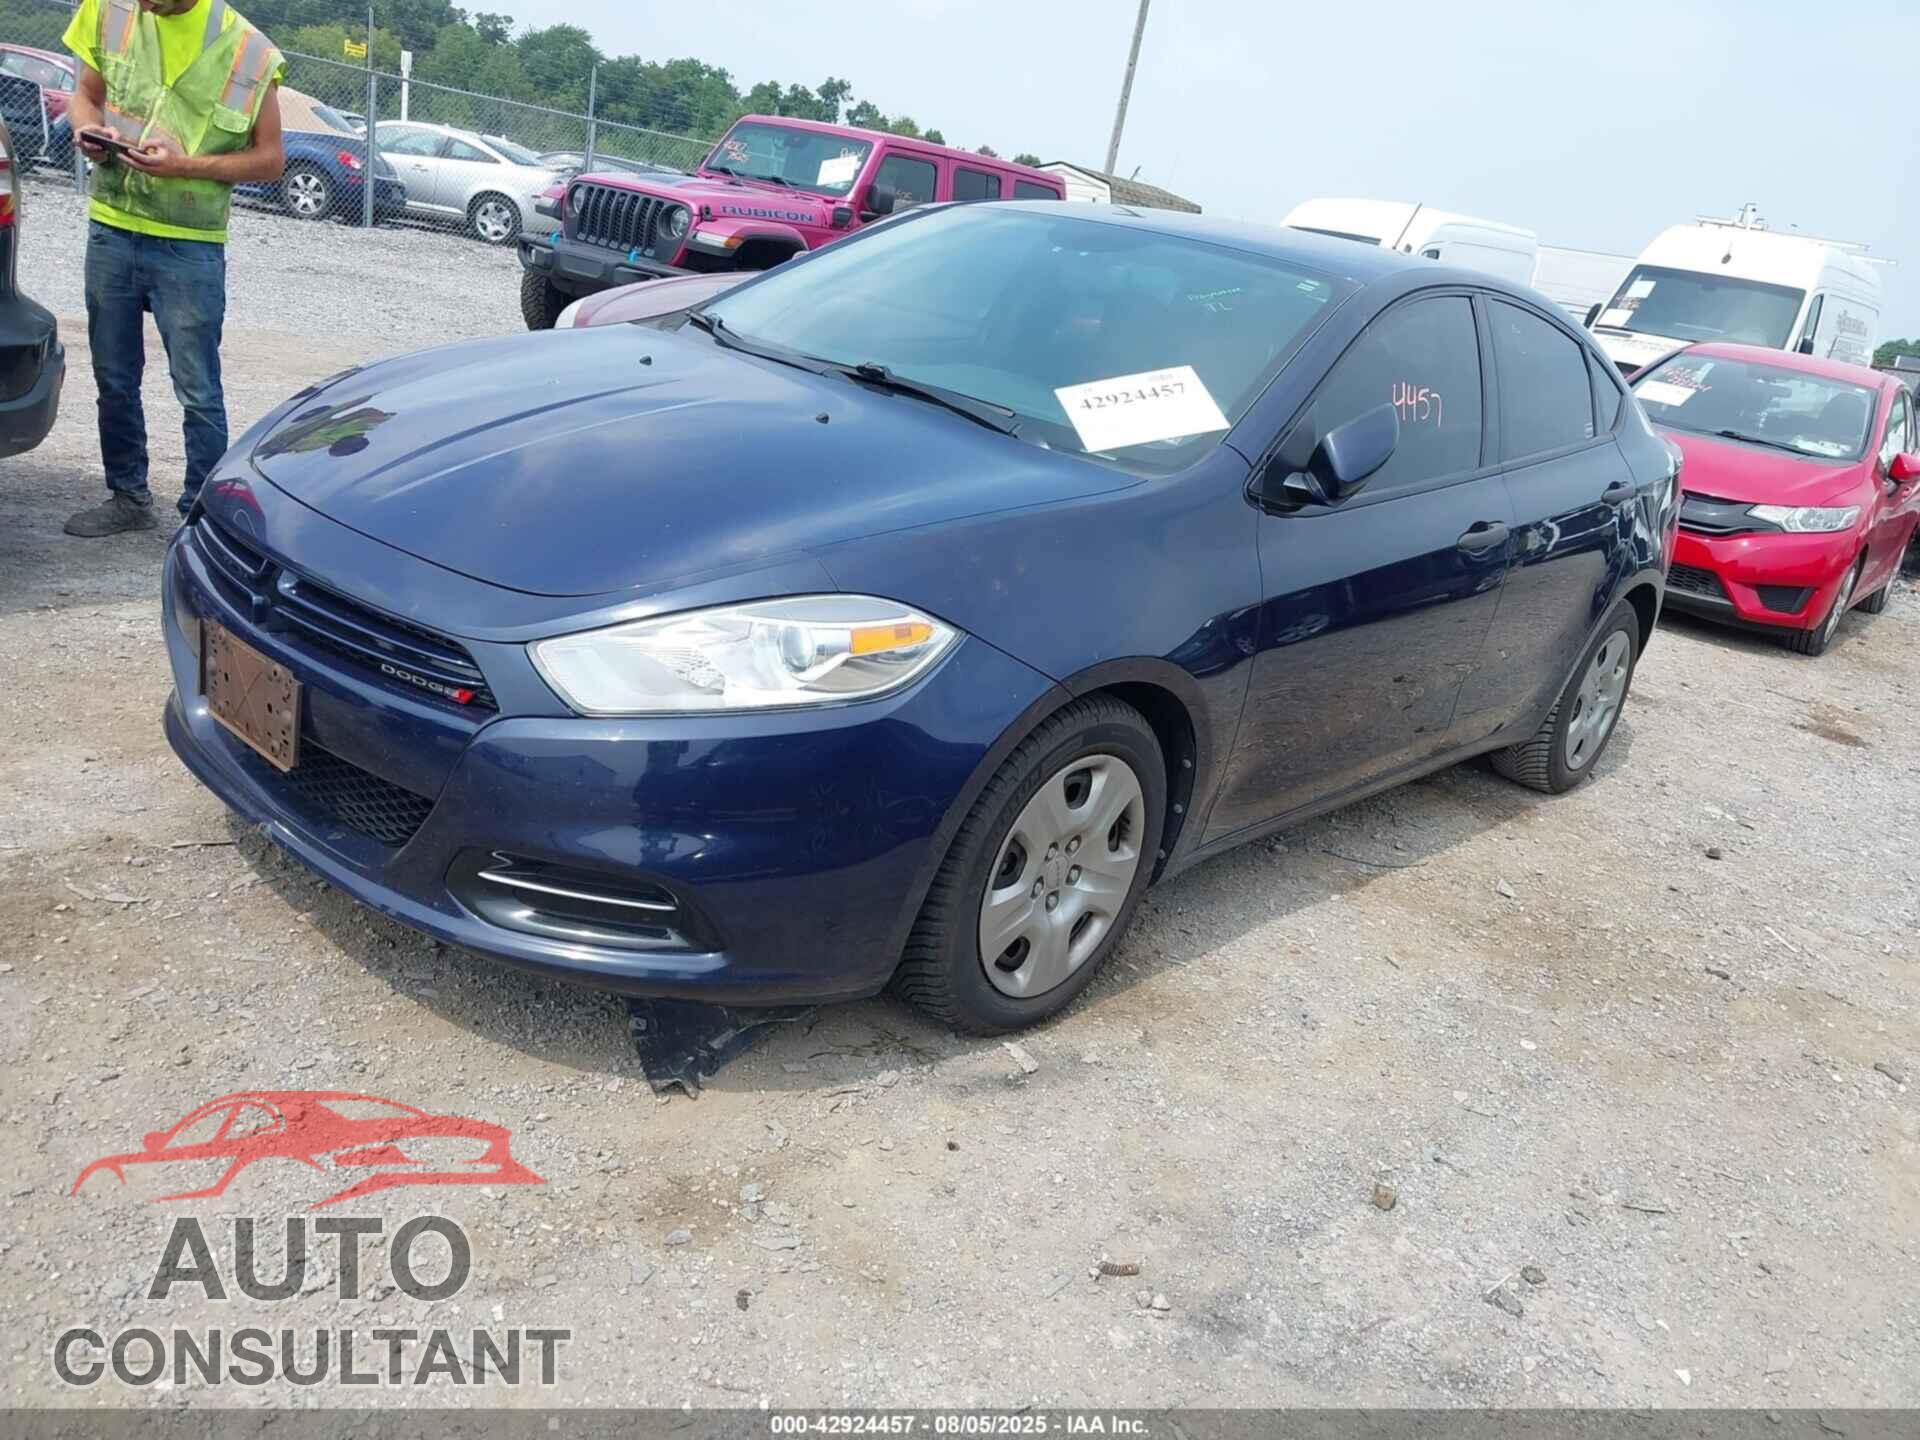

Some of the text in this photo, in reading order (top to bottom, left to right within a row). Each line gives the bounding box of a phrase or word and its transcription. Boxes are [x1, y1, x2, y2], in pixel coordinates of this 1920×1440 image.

[720, 205, 813, 223] RUBICON
[1080, 382, 1185, 410] 42924457
[1392, 381, 1442, 428] 4457
[381, 663, 457, 698] DODGE
